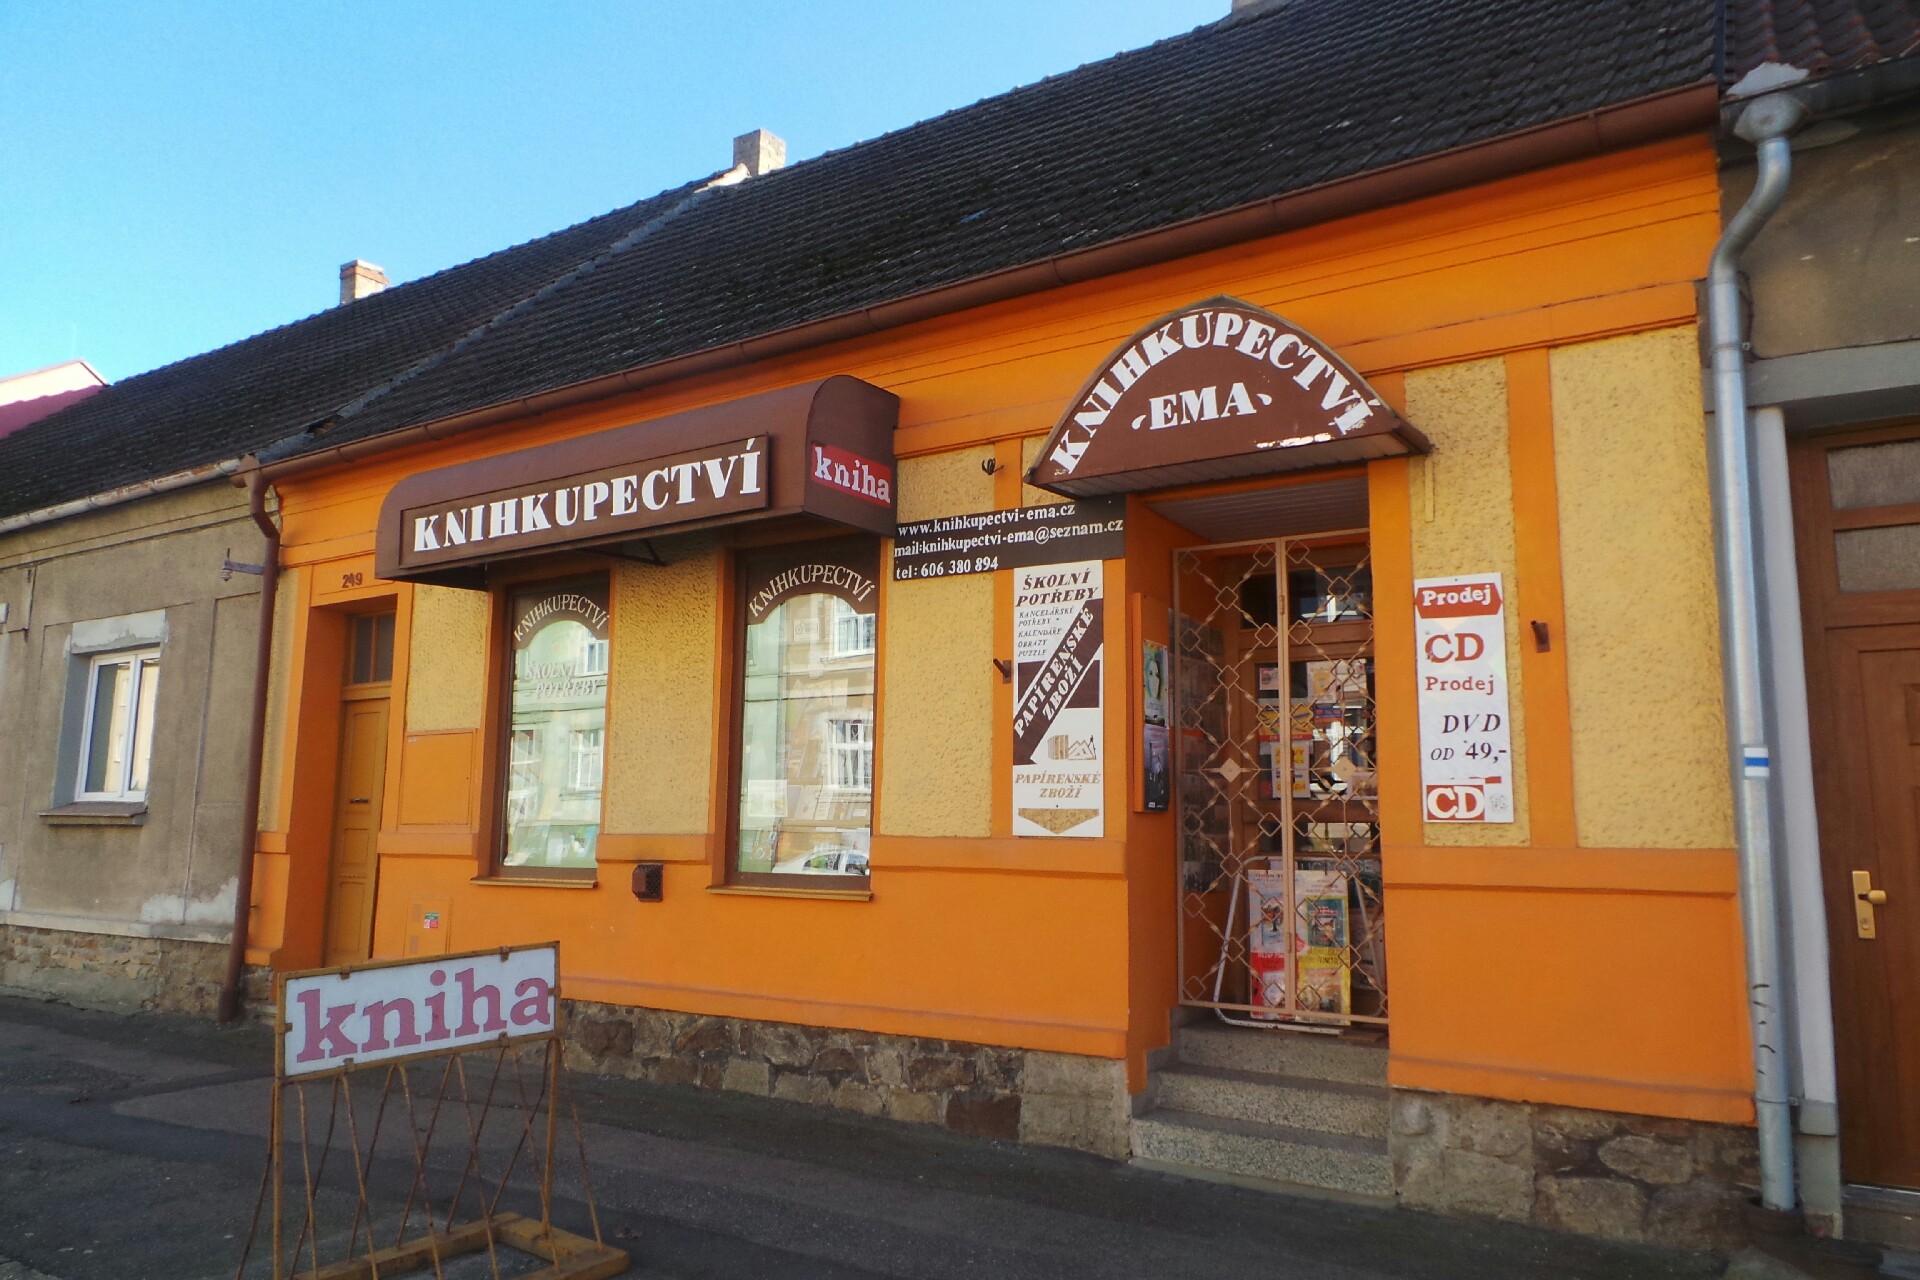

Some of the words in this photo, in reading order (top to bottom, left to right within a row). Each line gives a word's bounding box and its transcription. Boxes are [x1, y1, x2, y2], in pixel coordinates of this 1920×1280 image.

[1050, 311, 1380, 475] KNIHKUPECTVÍ
[1149, 382, 1257, 430] EMA
[813, 446, 891, 504] kniha
[414, 438, 761, 552] KNIHKUPECTVÍ
[898, 503, 1075, 536] www.knihkupectvi-ema.cz
[896, 564, 918, 579] tel:
[920, 562, 944, 577] 606
[948, 559, 971, 574] 380
[974, 556, 999, 571] 894
[1023, 567, 1091, 590] ŠKOLNÍ
[342, 572, 363, 588] 249
[1015, 587, 1098, 607] POTŘEBY
[1422, 584, 1491, 607] Prodej
[1018, 639, 1047, 648] OBRAZY
[1018, 649, 1047, 657] PUZZLE
[1425, 632, 1484, 663] CD
[1014, 607, 1094, 739] PAPÍRENSKÉ
[1042, 656, 1084, 722] ZBOŽÍ
[1425, 675, 1494, 695] Prodej
[1431, 748, 1454, 760] OD
[1015, 770, 1100, 785] PAPÍRENSKÉ
[1039, 786, 1082, 799] ZBOŽÍ
[1427, 785, 1484, 819] CD
[297, 968, 550, 1063] kniha
